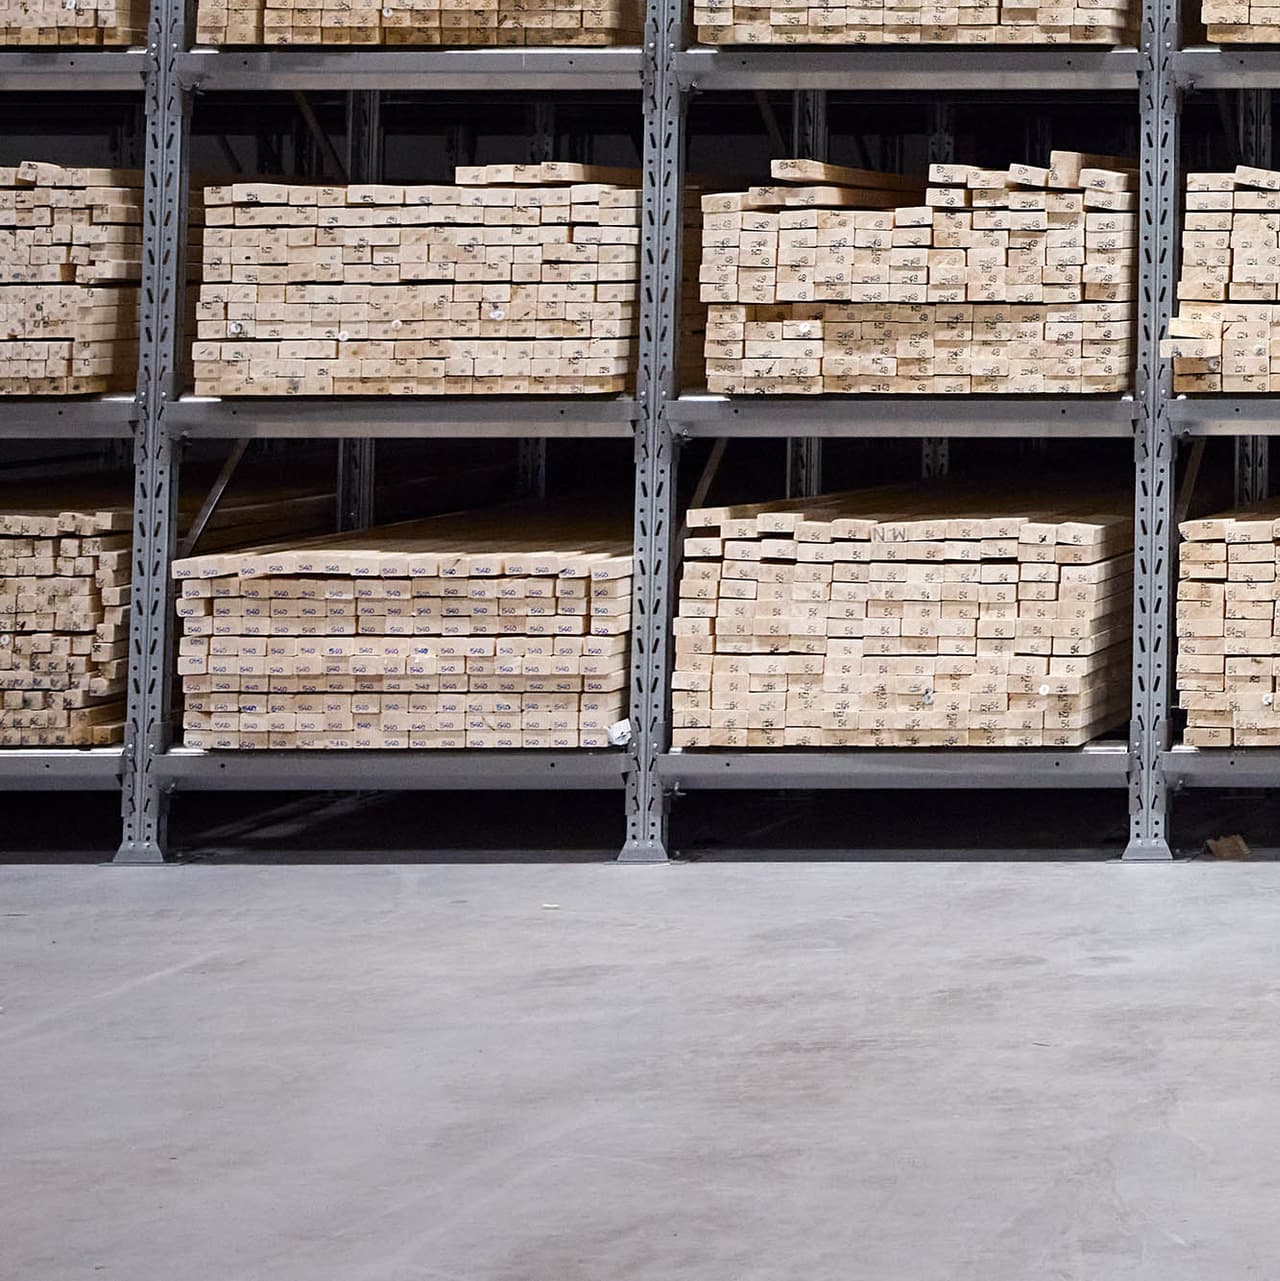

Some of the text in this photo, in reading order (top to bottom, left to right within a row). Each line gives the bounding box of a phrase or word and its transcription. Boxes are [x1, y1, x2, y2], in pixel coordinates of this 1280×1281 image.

[240, 568, 256, 576] 540
[268, 565, 284, 573] 540
[298, 564, 313, 572] 540
[176, 569, 191, 577] 540
[187, 626, 202, 634] 540
[594, 627, 609, 635] 540
[242, 647, 257, 655] 540
[469, 647, 485, 655] 540
[440, 665, 455, 673] 540
[498, 665, 513, 673] 540
[496, 739, 513, 747] 540
